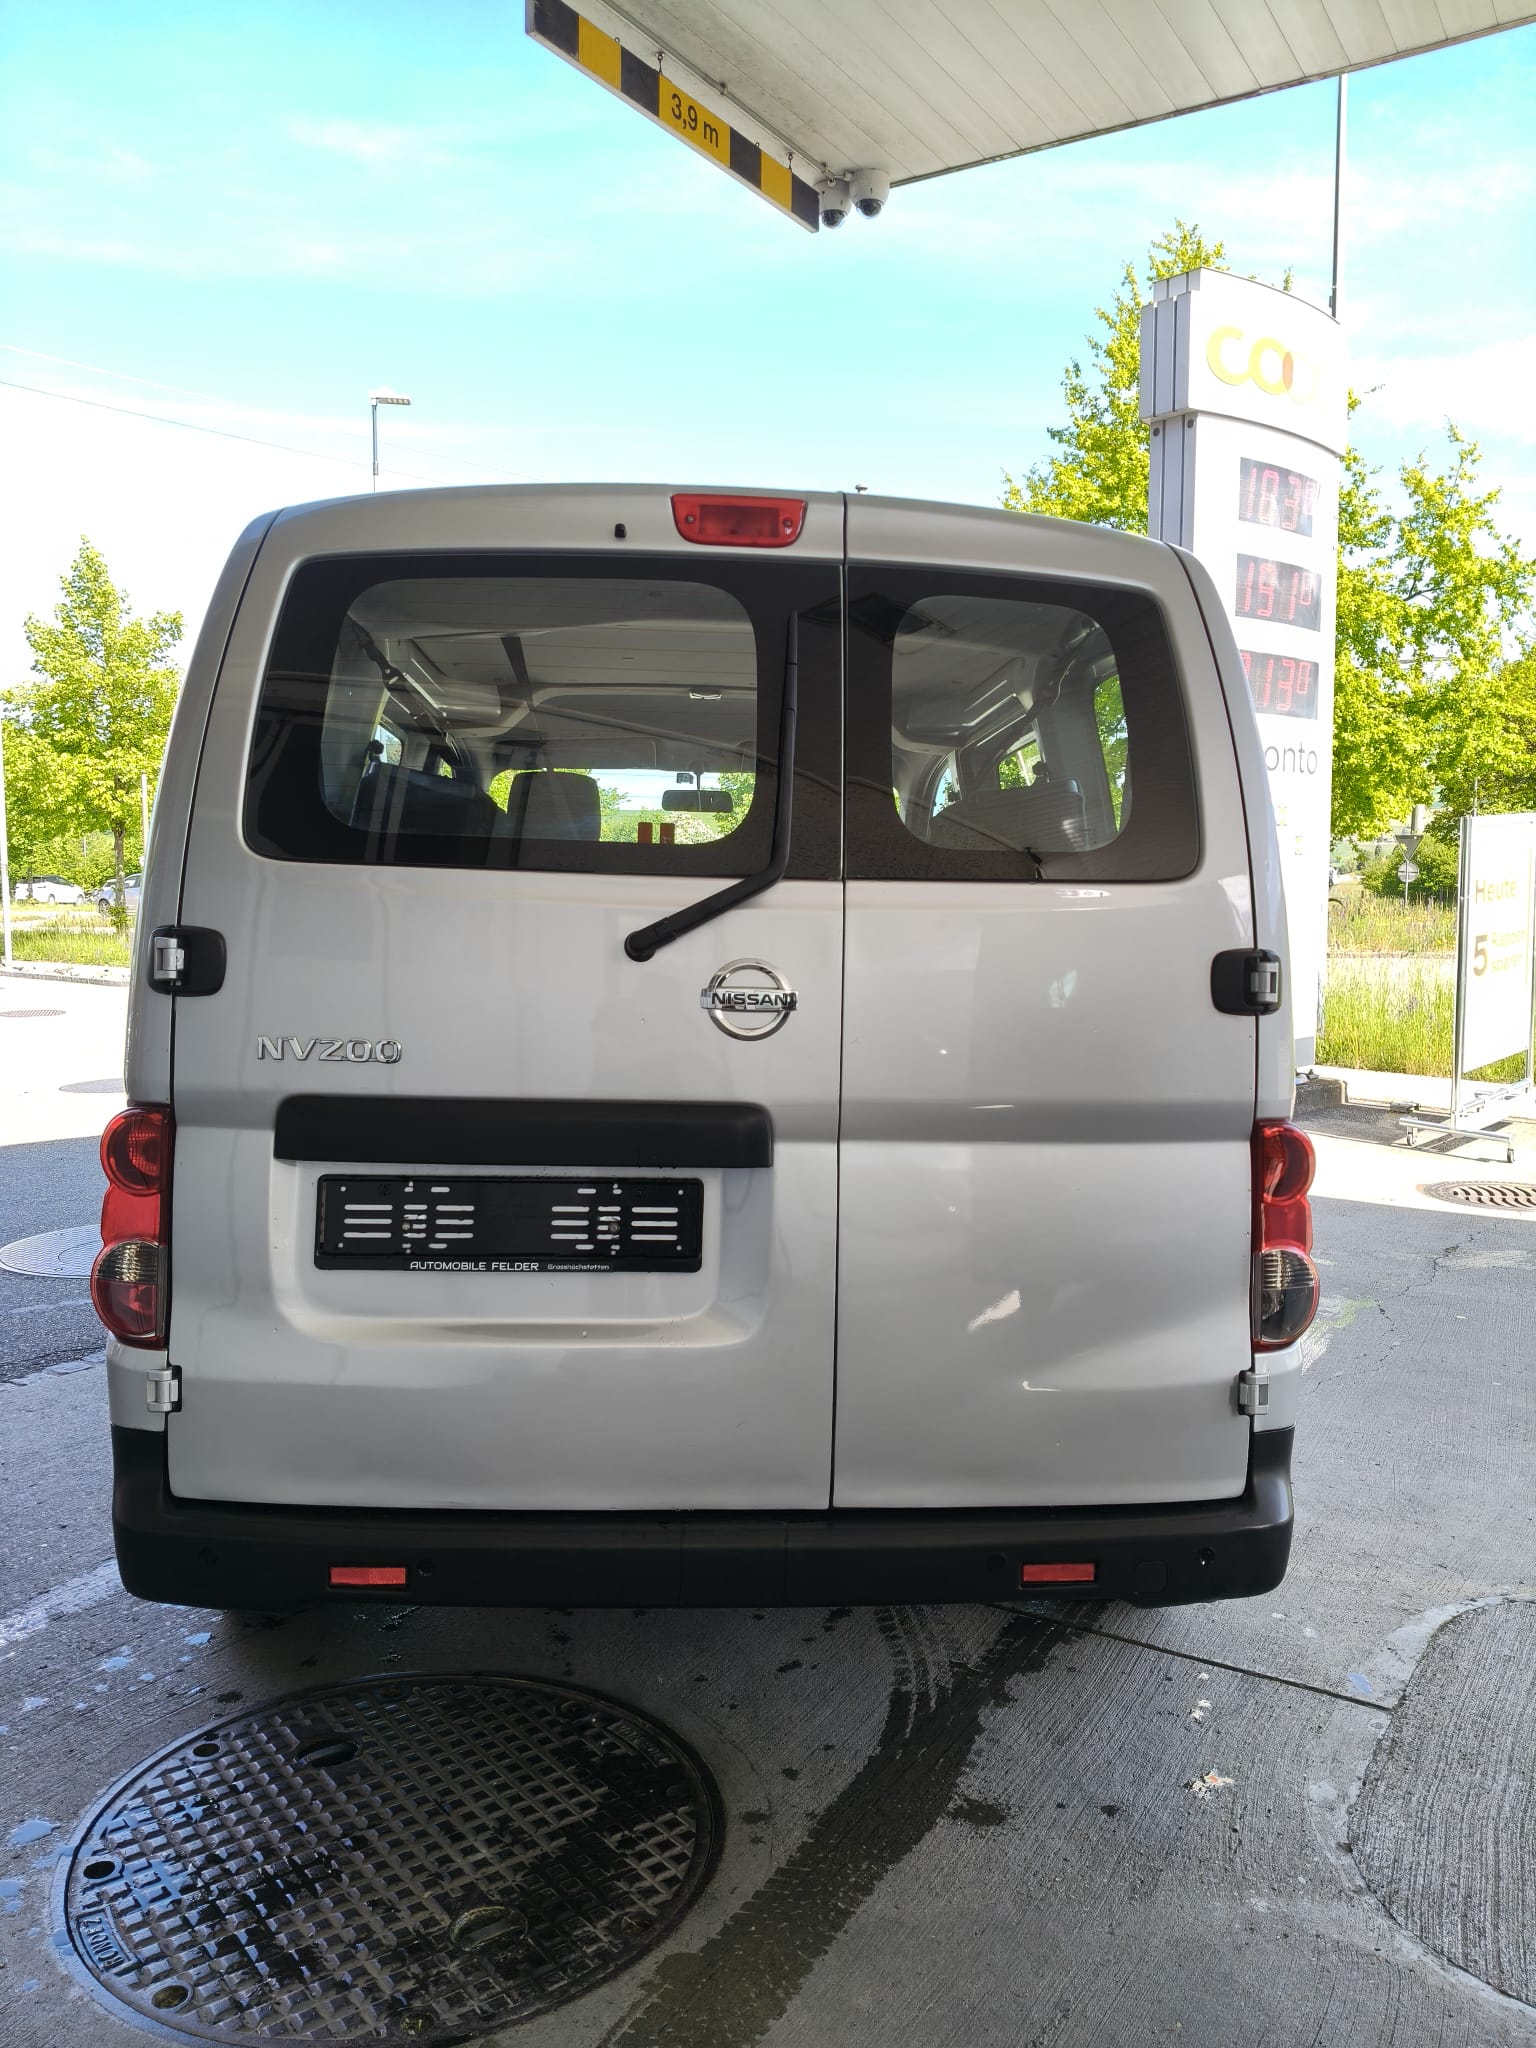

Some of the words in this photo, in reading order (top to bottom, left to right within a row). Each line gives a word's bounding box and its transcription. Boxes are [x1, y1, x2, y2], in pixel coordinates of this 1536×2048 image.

[671, 93, 698, 131] 3,9
[703, 121, 719, 149] m
[1264, 741, 1317, 775] onto
[1475, 879, 1517, 904] Heute
[1474, 934, 1489, 976] 5
[711, 992, 788, 1006] NISSAN
[257, 1037, 402, 1063] NV200
[410, 1261, 487, 1271] AUTOMOBILE
[492, 1262, 539, 1271] FELDER
